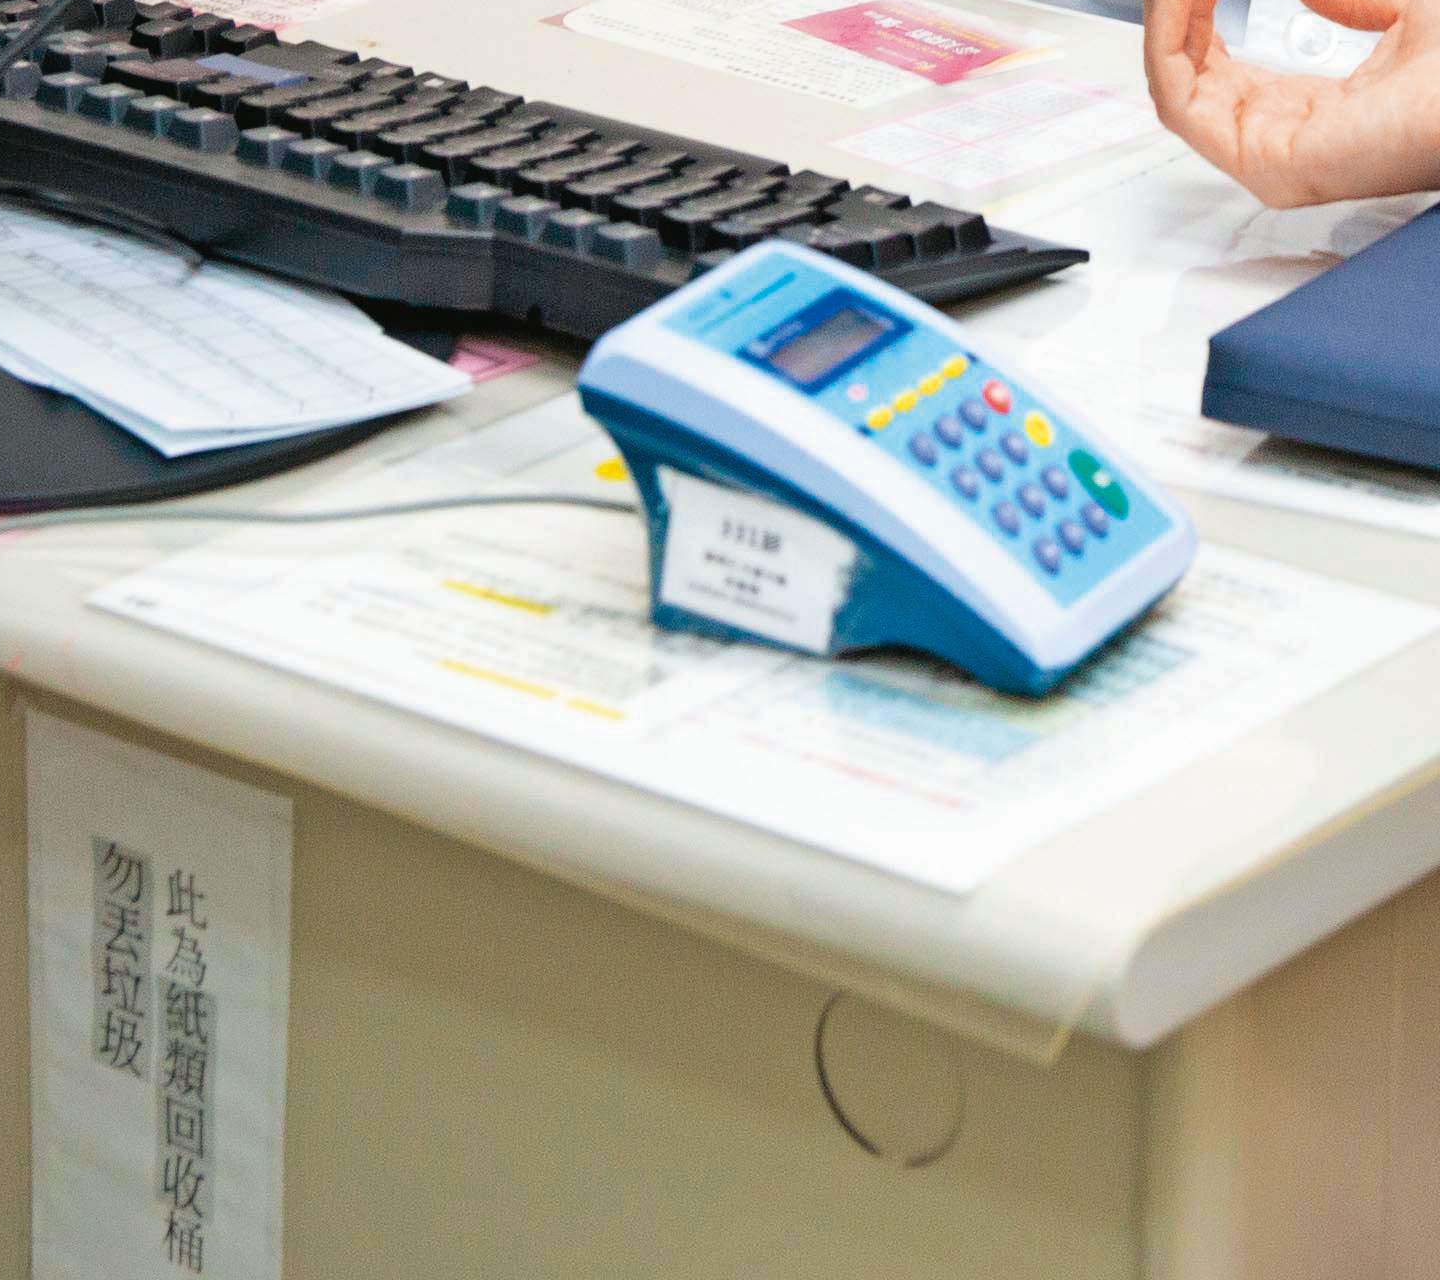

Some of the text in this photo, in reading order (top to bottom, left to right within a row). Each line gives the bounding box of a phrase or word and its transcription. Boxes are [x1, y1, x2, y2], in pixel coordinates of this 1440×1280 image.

[101, 842, 144, 1077] 勿丟垃圾
[163, 868, 208, 1274] 此為紙類回收桶
